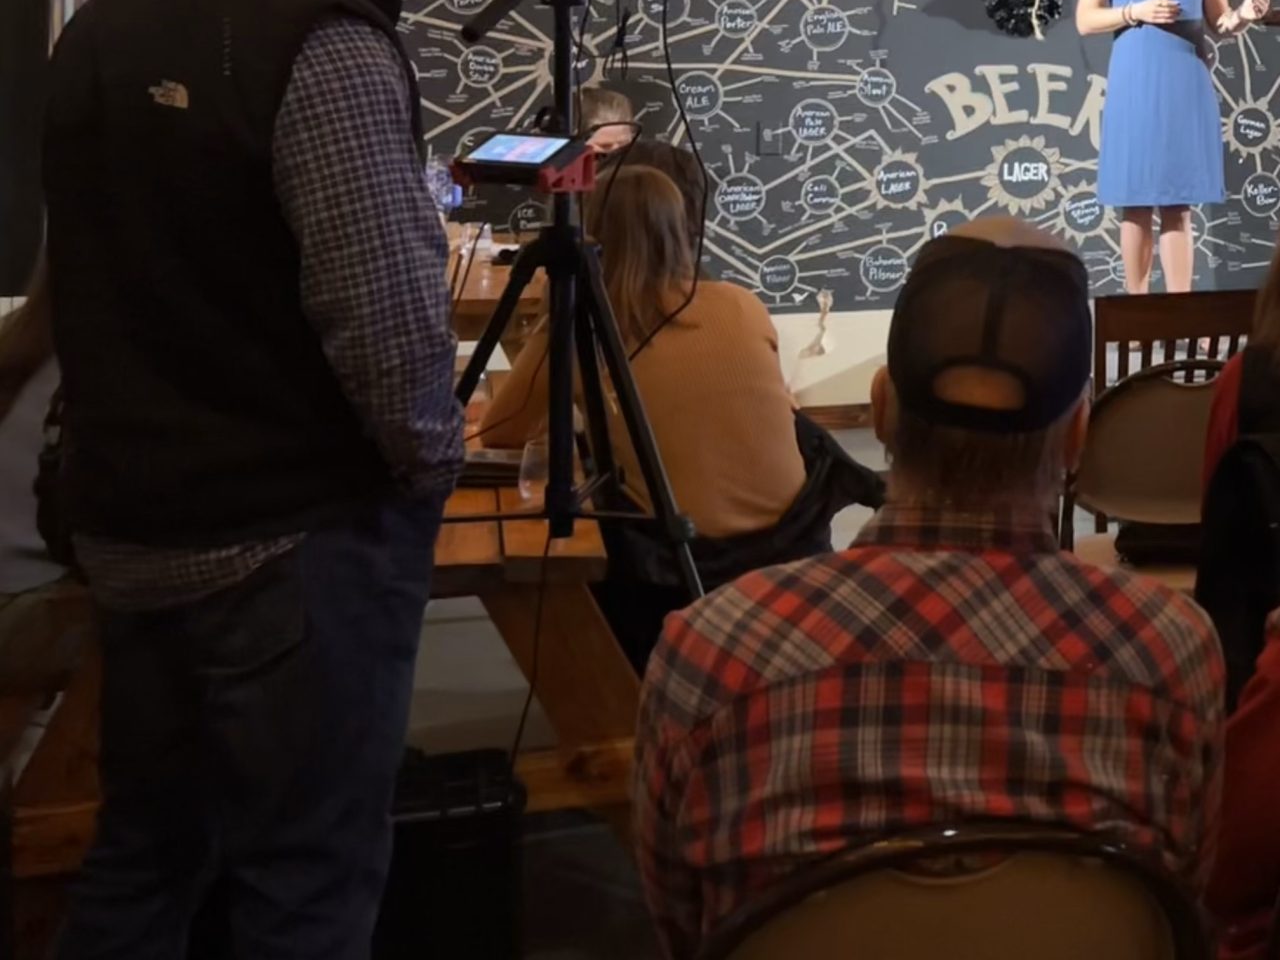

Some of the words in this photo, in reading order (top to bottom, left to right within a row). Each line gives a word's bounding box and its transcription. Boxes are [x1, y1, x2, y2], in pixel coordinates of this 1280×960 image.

[679, 84, 715, 94] Cream
[685, 95, 710, 108] ALE
[877, 169, 918, 181] American
[1003, 161, 1049, 183] LAGER
